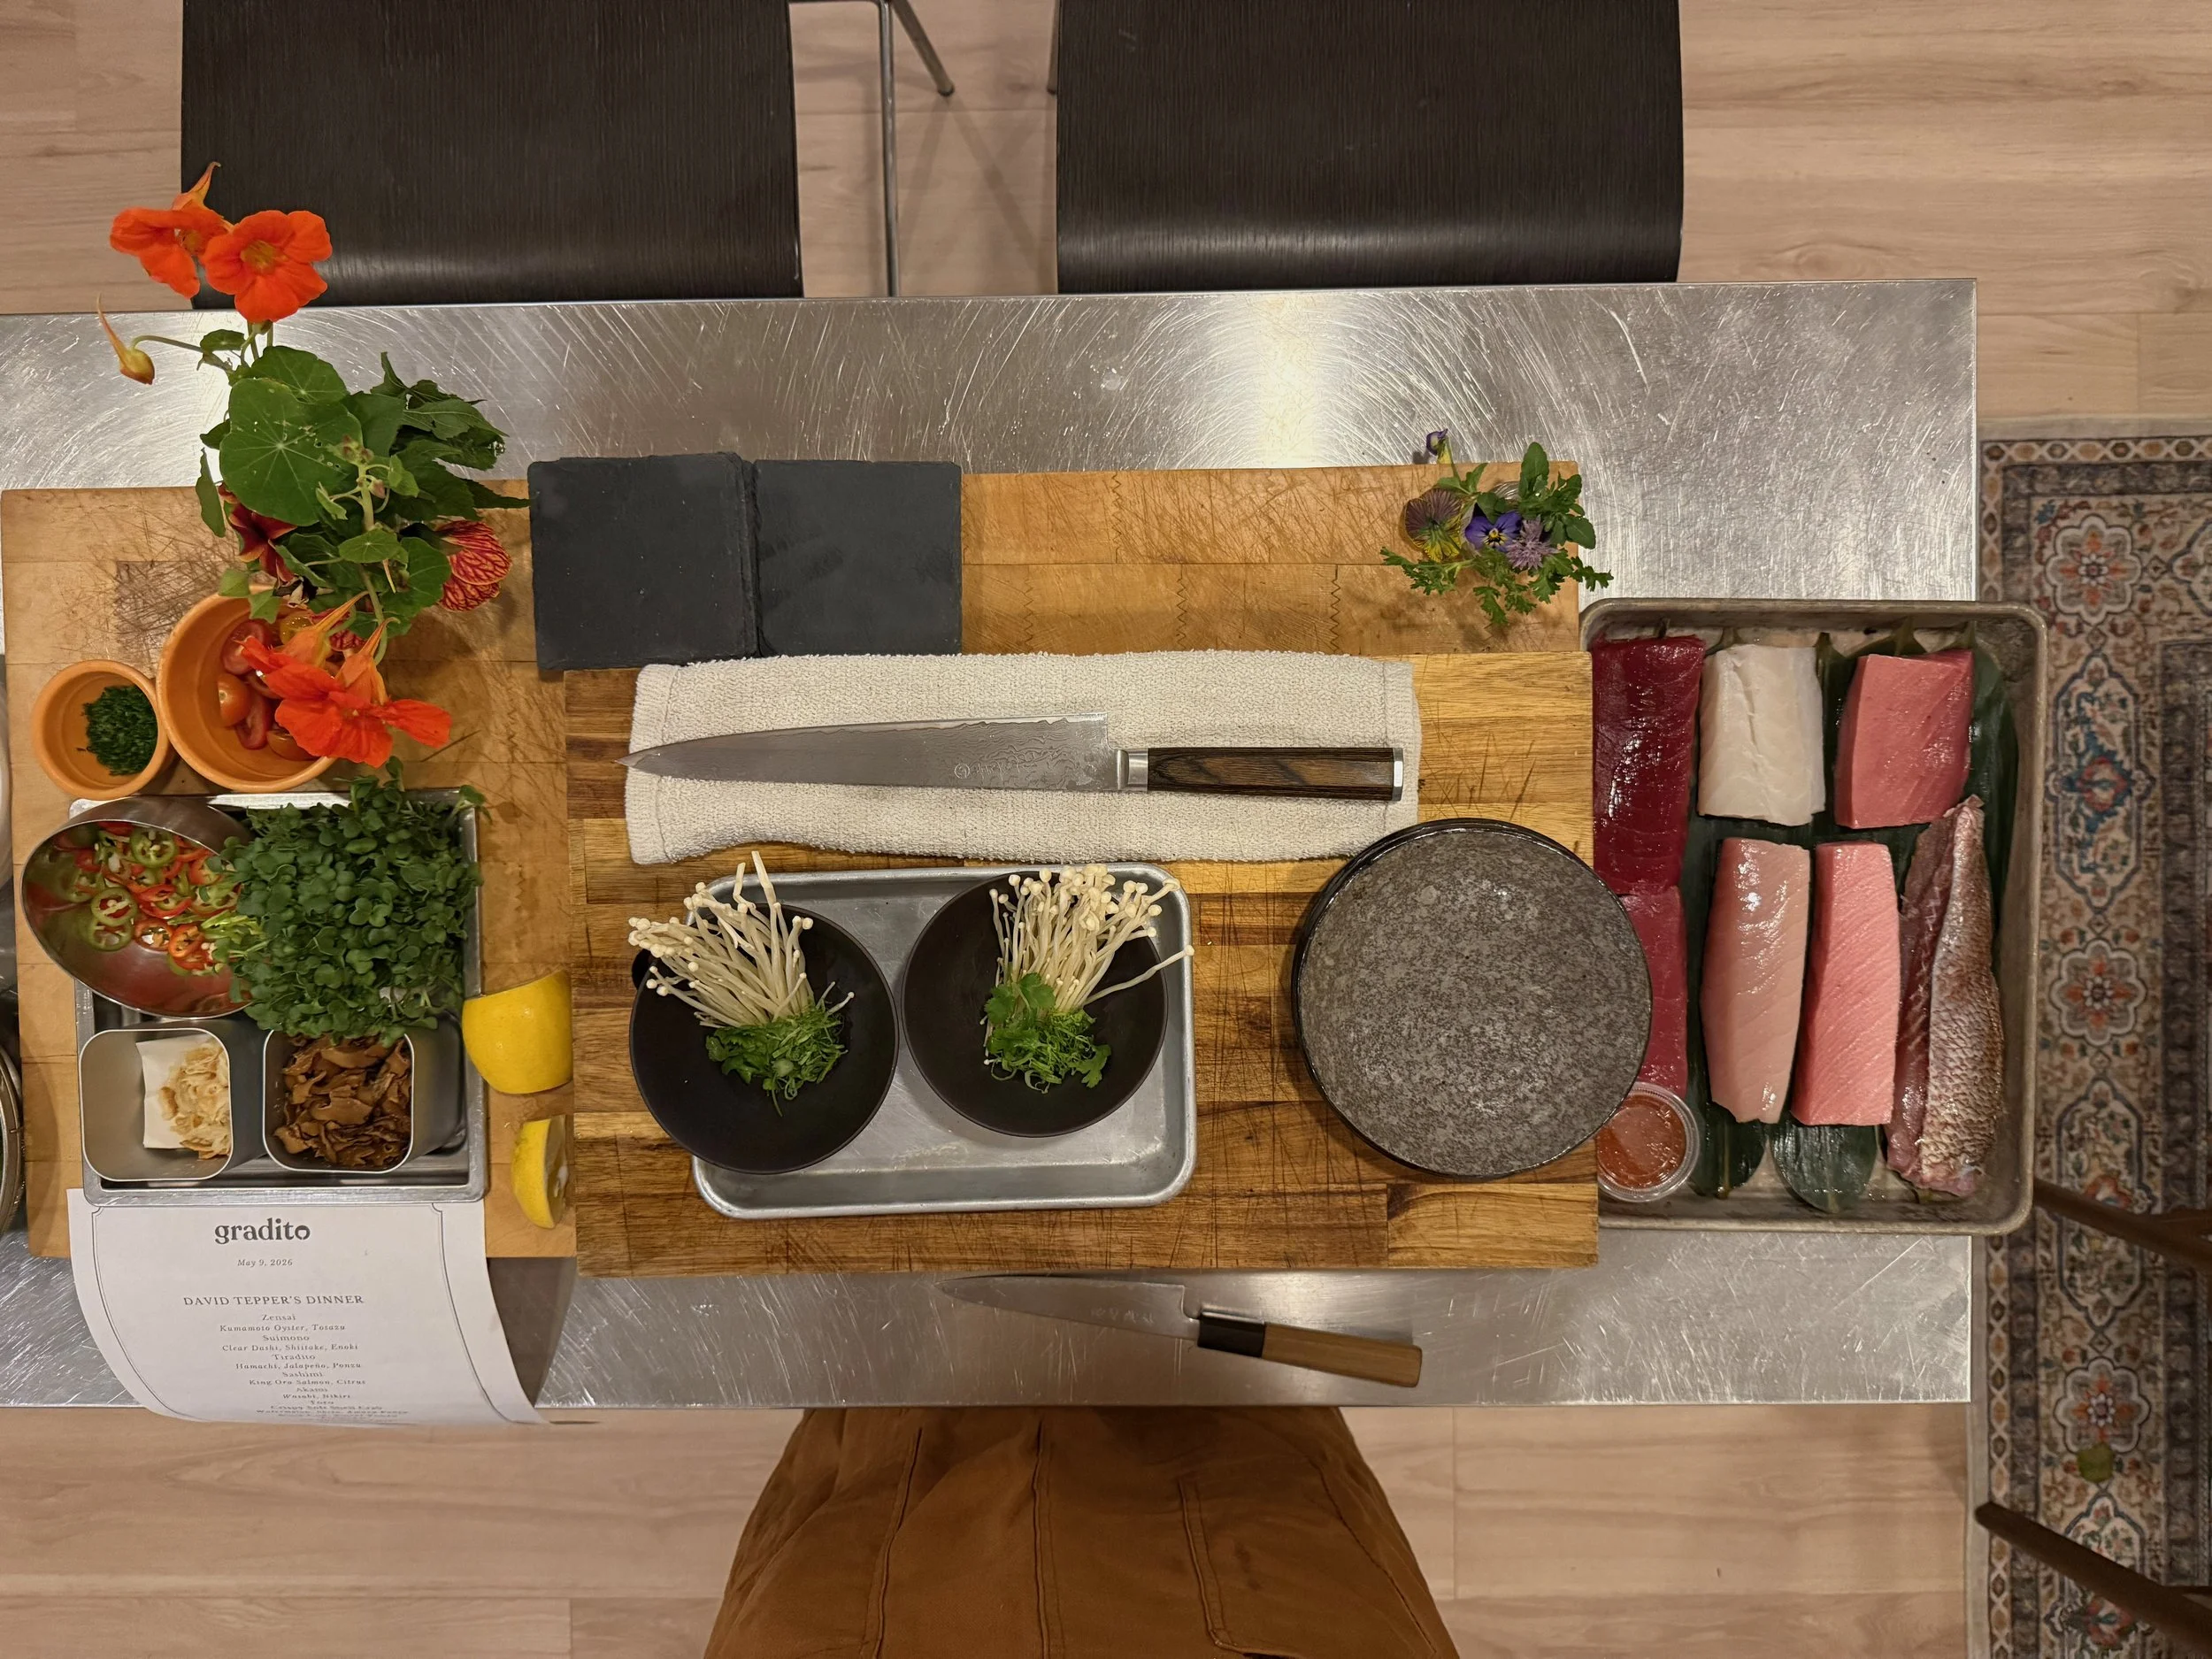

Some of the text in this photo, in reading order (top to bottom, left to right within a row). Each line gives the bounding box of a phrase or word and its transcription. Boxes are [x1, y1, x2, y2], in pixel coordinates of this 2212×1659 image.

[215, 1217, 311, 1245] gradito
[237, 1259, 256, 1268] May
[183, 1295, 365, 1306] DAVID TEPPER'S DINNER
